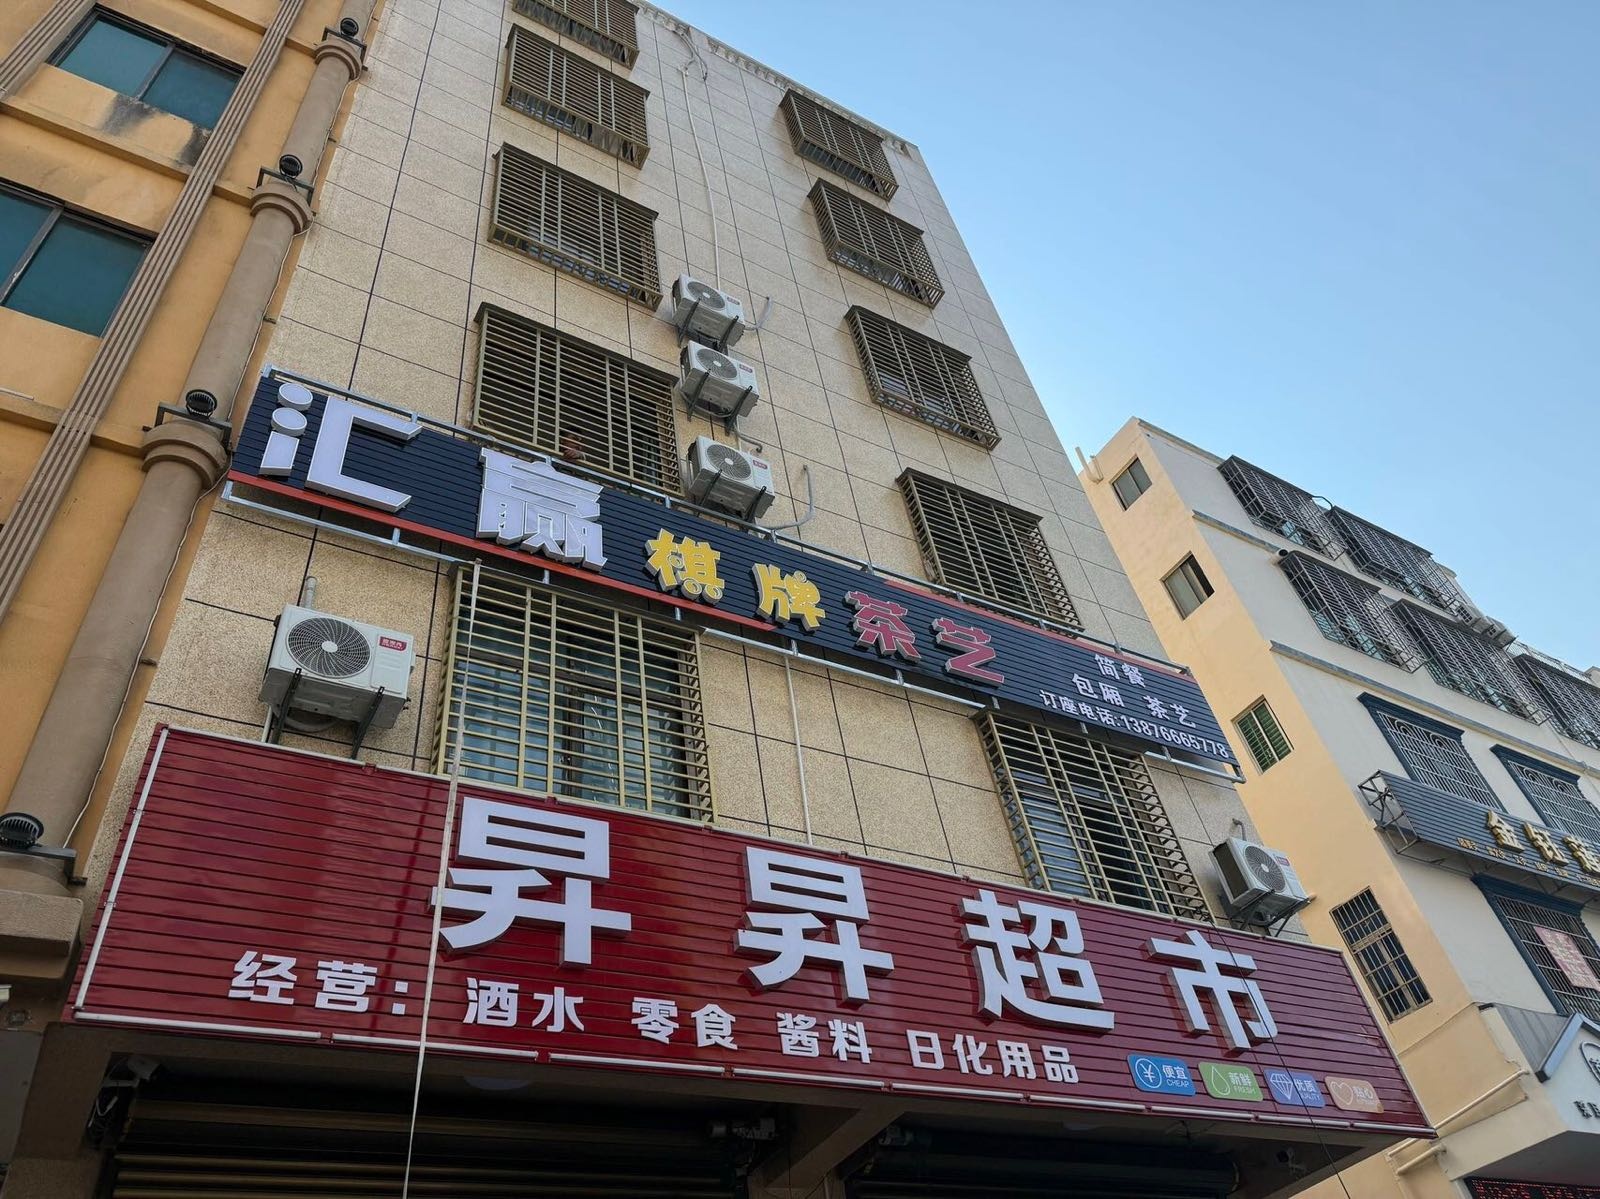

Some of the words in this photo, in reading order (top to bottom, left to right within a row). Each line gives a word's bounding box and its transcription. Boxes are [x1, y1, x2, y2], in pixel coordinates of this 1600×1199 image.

[258, 382, 608, 572] 汇赢
[644, 528, 826, 632] 棋牌
[844, 590, 1005, 684] 茶艺
[1094, 653, 1146, 689] 简餐
[1072, 673, 1125, 708] 包厢
[1143, 694, 1197, 728] 茶艺
[462, 977, 585, 1033] 酒水
[630, 996, 739, 1051] 零食
[776, 1012, 872, 1064] 酱料
[906, 1029, 1079, 1084] 日化用品
[1162, 1064, 1188, 1080] 便宜
[1166, 1079, 1190, 1088] CHEAP
[1228, 1071, 1252, 1087] 新鲜
